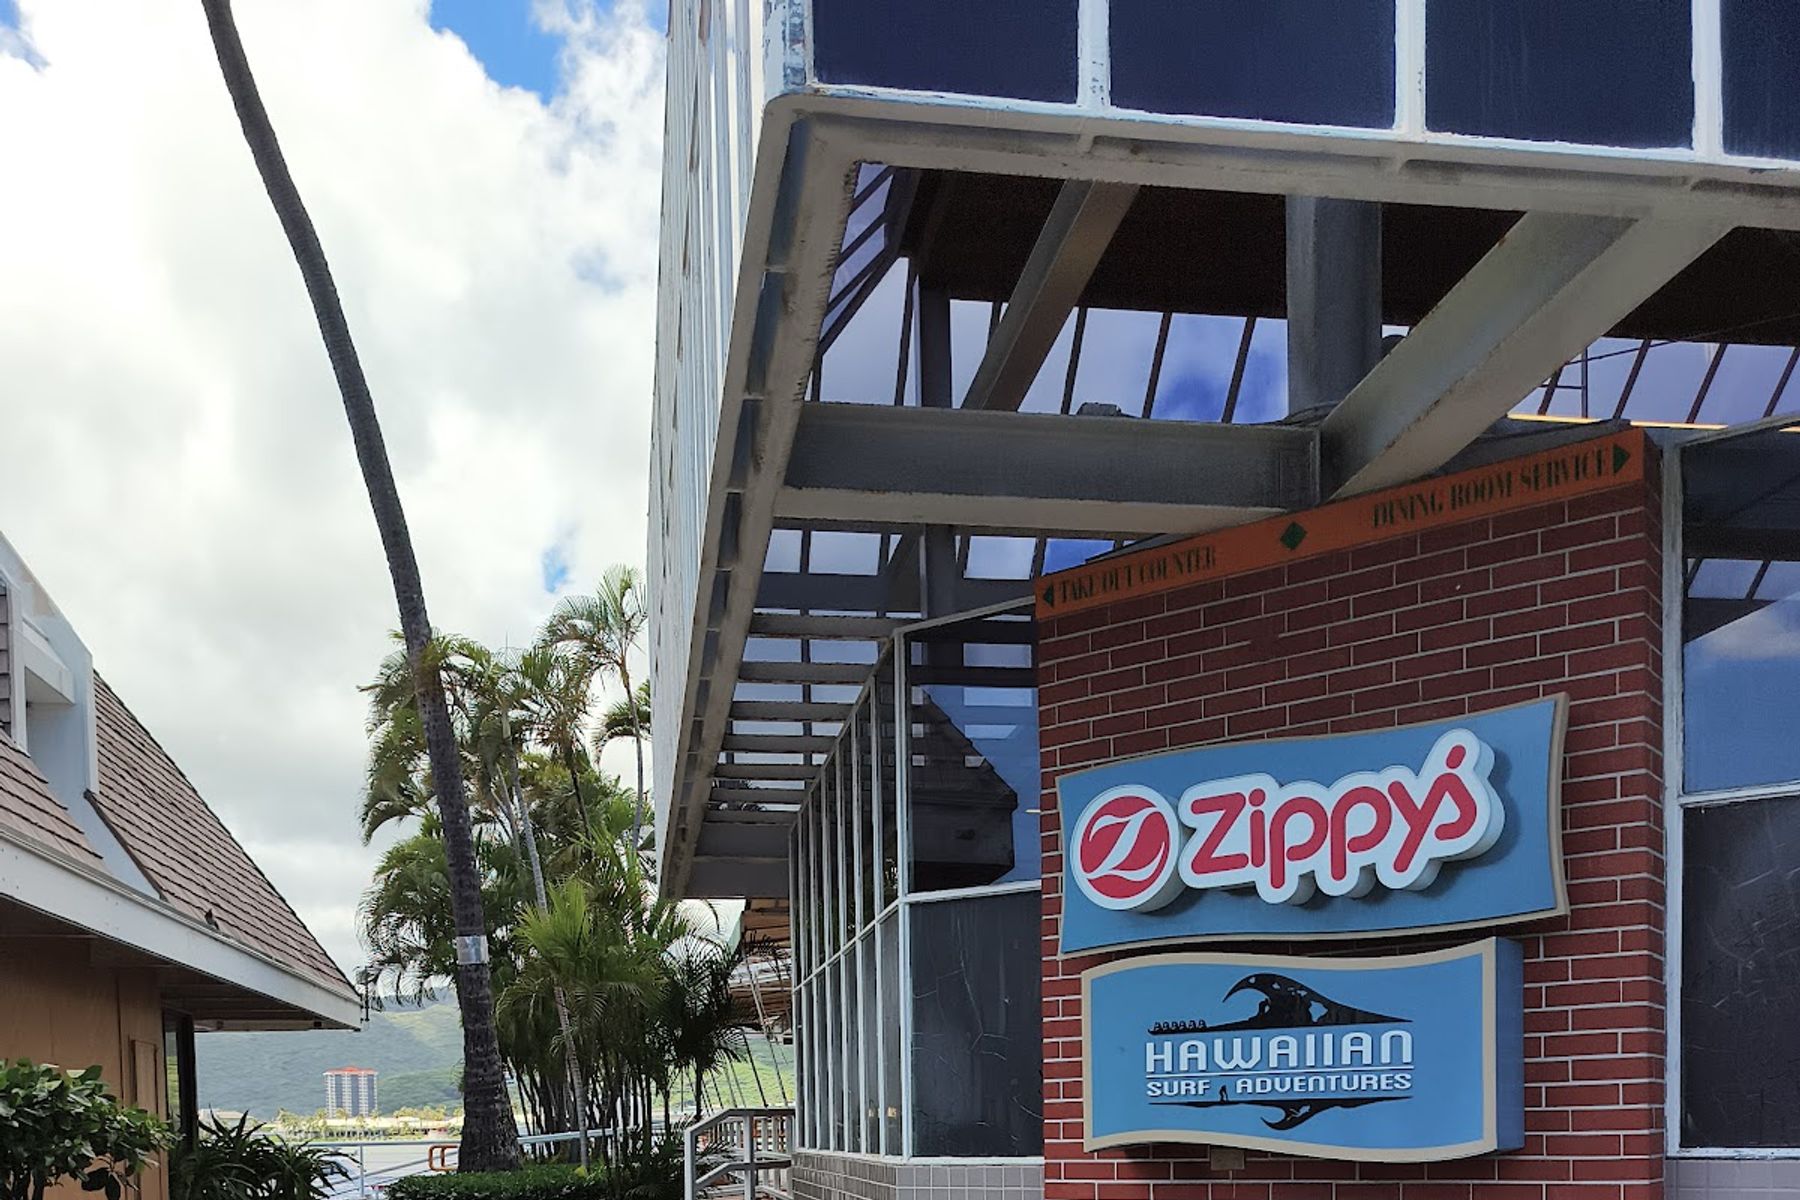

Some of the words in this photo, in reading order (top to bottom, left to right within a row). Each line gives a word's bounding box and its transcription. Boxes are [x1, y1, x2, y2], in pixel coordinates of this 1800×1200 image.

[1451, 470, 1513, 511] ROOM
[1146, 1030, 1414, 1073] HAWAIIAN
[1146, 1079, 1210, 1097] SURF
[1236, 1073, 1412, 1094] ADVENTURES
